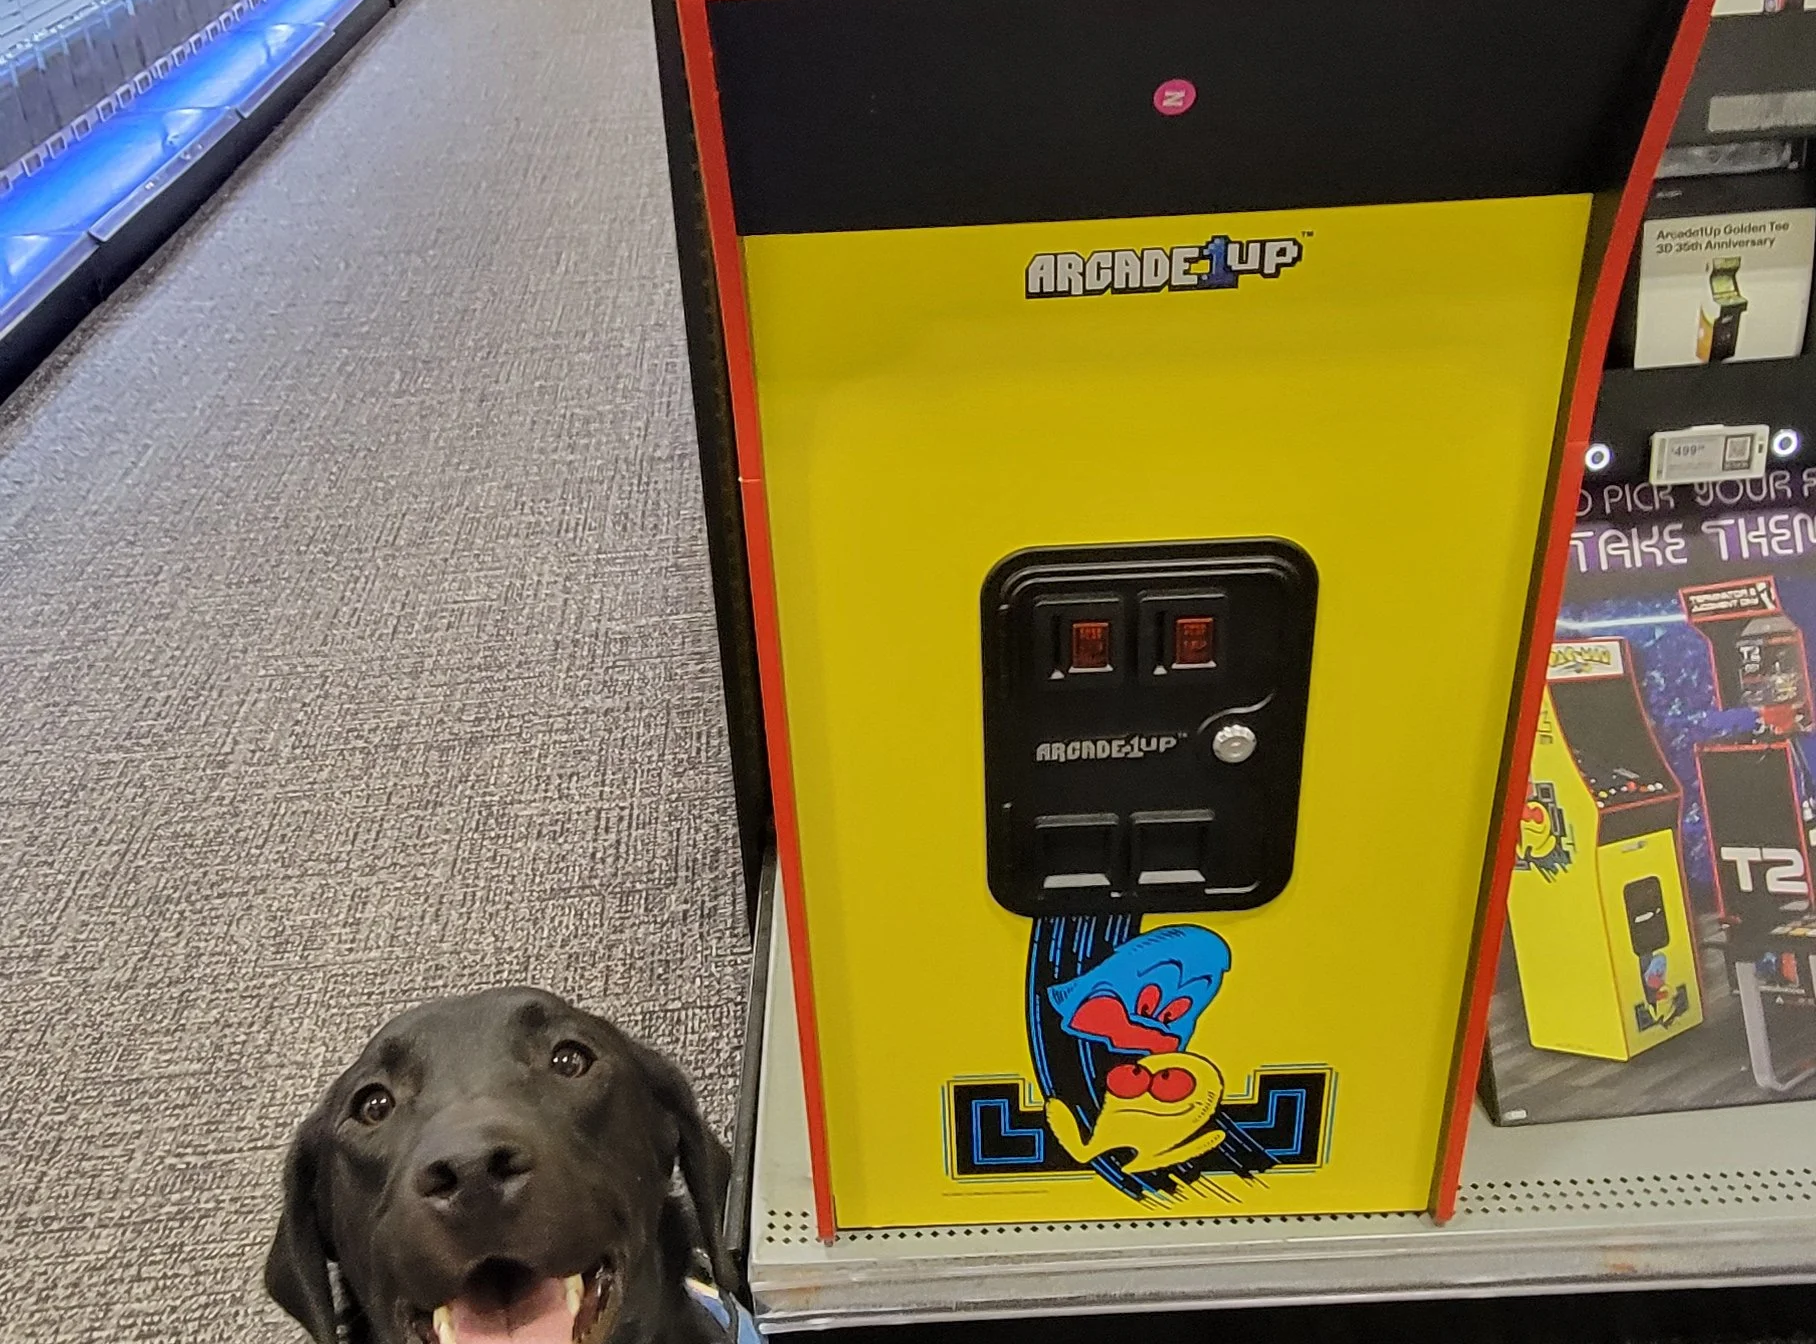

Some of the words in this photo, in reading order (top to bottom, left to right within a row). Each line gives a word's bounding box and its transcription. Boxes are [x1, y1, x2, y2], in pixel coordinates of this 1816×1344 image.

[1656, 227, 1721, 241] Arcade1Up
[1723, 222, 1766, 236] Golden
[1656, 243, 1673, 254] 3D
[1704, 237, 1776, 251] Anniversary
[1603, 482, 1675, 514] PICK
[1694, 470, 1792, 506] YOUR
[1569, 523, 1688, 573] TAKE
[1720, 846, 1809, 894] T2
